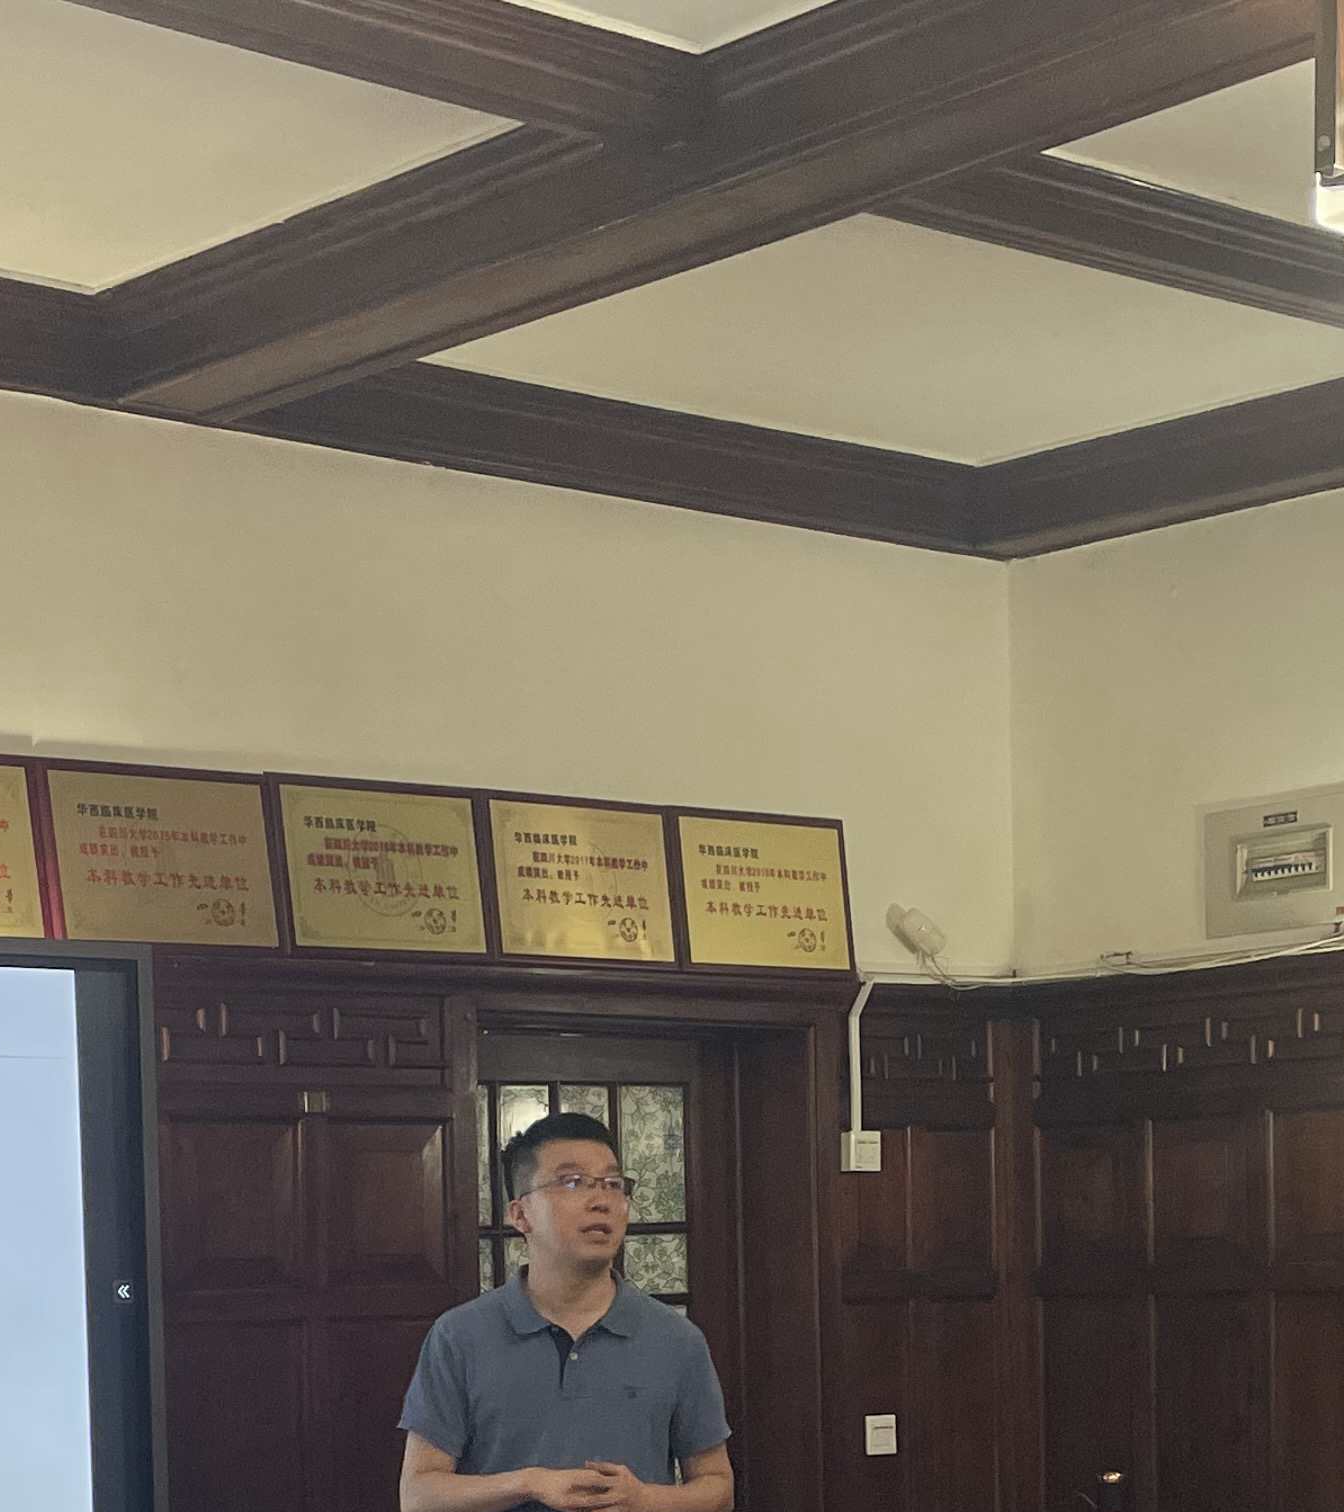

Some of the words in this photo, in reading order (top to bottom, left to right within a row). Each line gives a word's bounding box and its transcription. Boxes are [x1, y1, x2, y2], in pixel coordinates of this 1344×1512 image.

[87, 869, 249, 891] 本科教学工作先进单位
[313, 878, 459, 899] 本科教学工作先进单位
